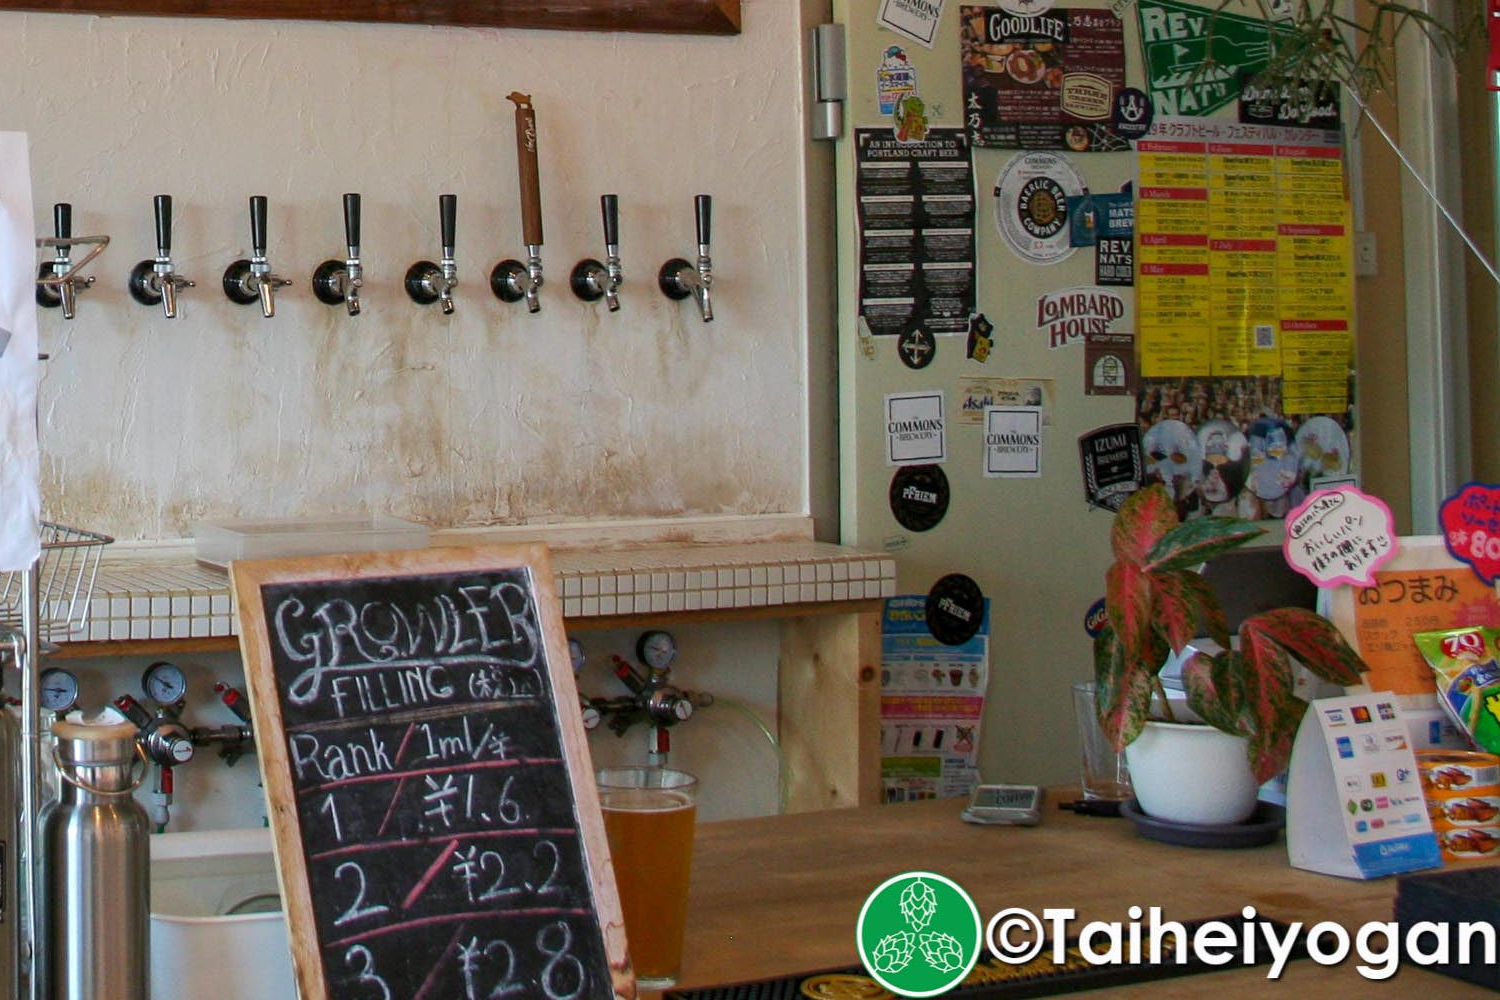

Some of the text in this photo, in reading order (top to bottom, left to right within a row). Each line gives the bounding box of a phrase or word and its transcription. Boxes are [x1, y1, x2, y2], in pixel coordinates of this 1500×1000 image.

[990, 13, 1064, 42] GOODLIFE
[1051, 184, 1066, 212] BEER
[1024, 218, 1061, 235] COMPANY
[1037, 293, 1124, 328] LOMBARD
[1050, 318, 1110, 348] HOUSE
[888, 420, 943, 433] COMMONS
[987, 434, 1039, 445] COMMONS
[1094, 434, 1127, 451] IZUMI
[330, 665, 454, 718] FILLING
[290, 728, 394, 781] Rank
[321, 793, 343, 842] 1
[334, 861, 389, 927] 2
[344, 944, 391, 1000] 3
